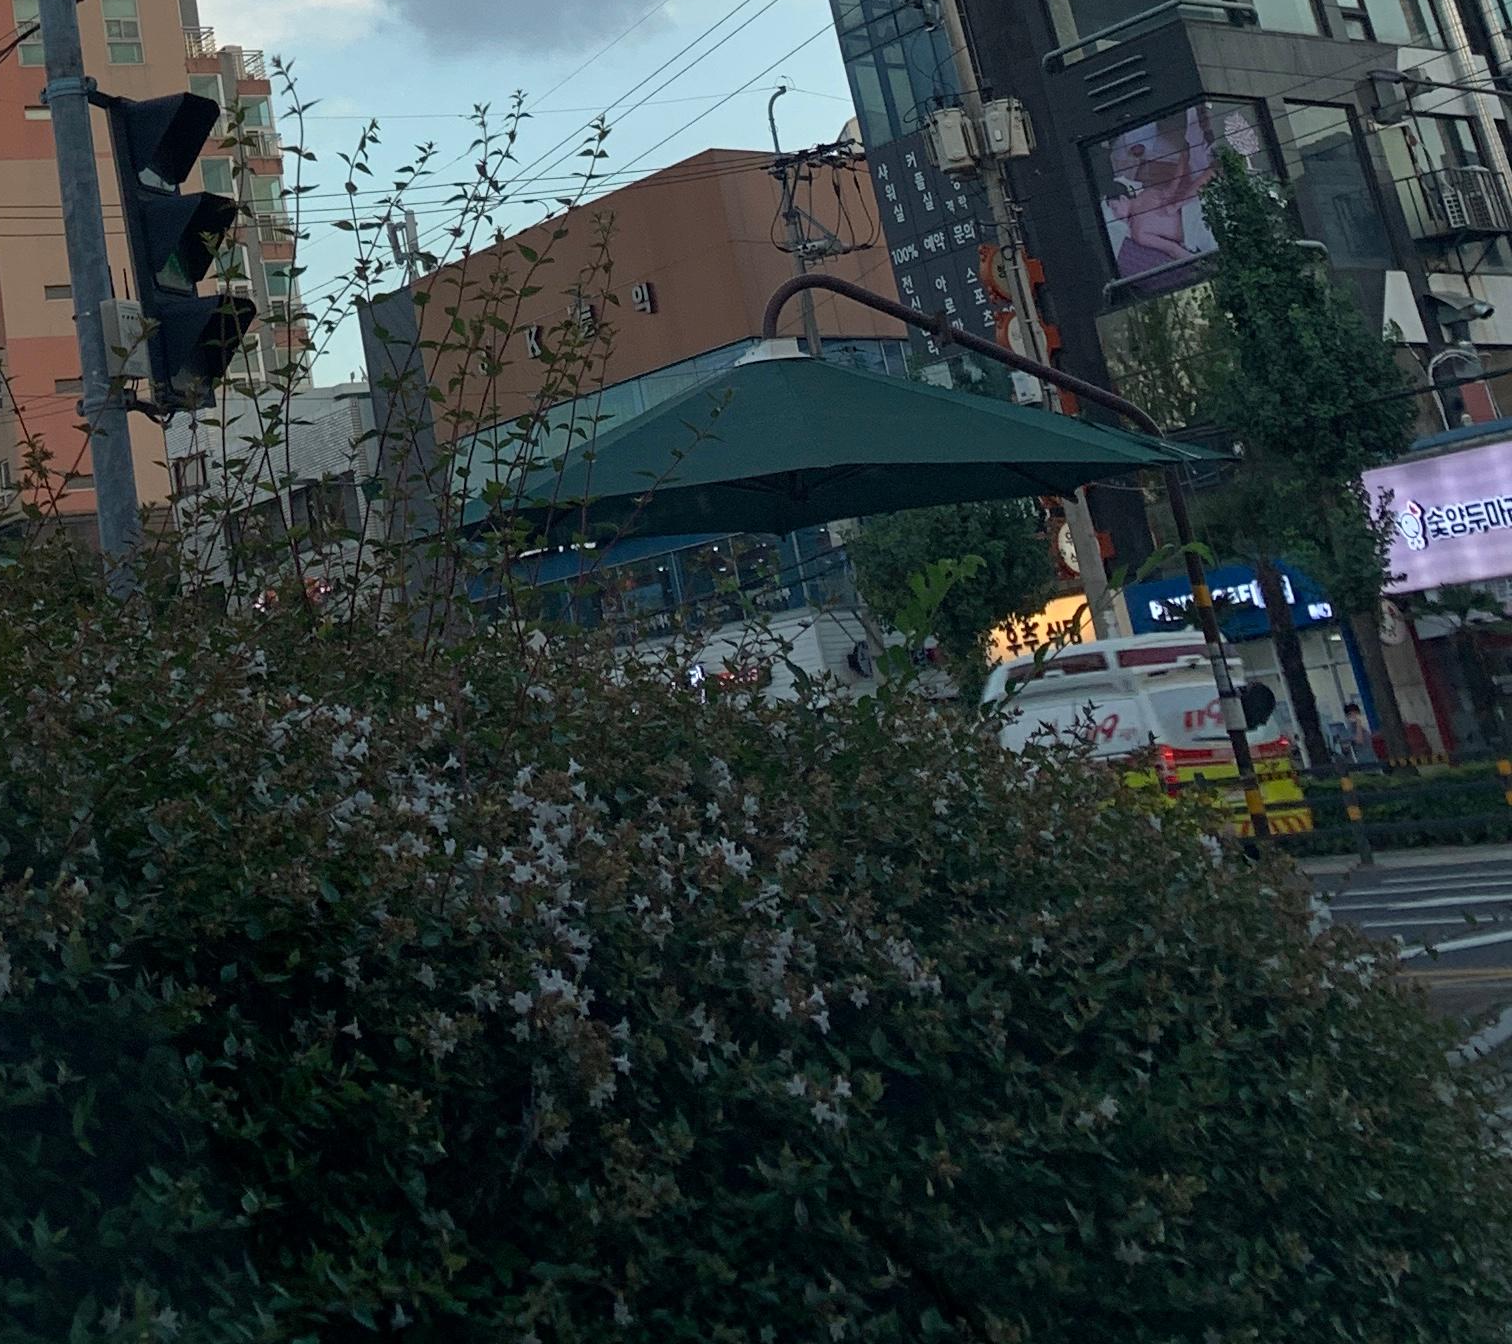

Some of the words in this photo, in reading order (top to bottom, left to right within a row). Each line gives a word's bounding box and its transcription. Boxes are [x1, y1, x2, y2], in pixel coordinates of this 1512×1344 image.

[891, 243, 919, 267] 100%
[923, 231, 947, 253] 예약
[953, 221, 977, 245] 문의
[966, 267, 995, 327] 스포츠
